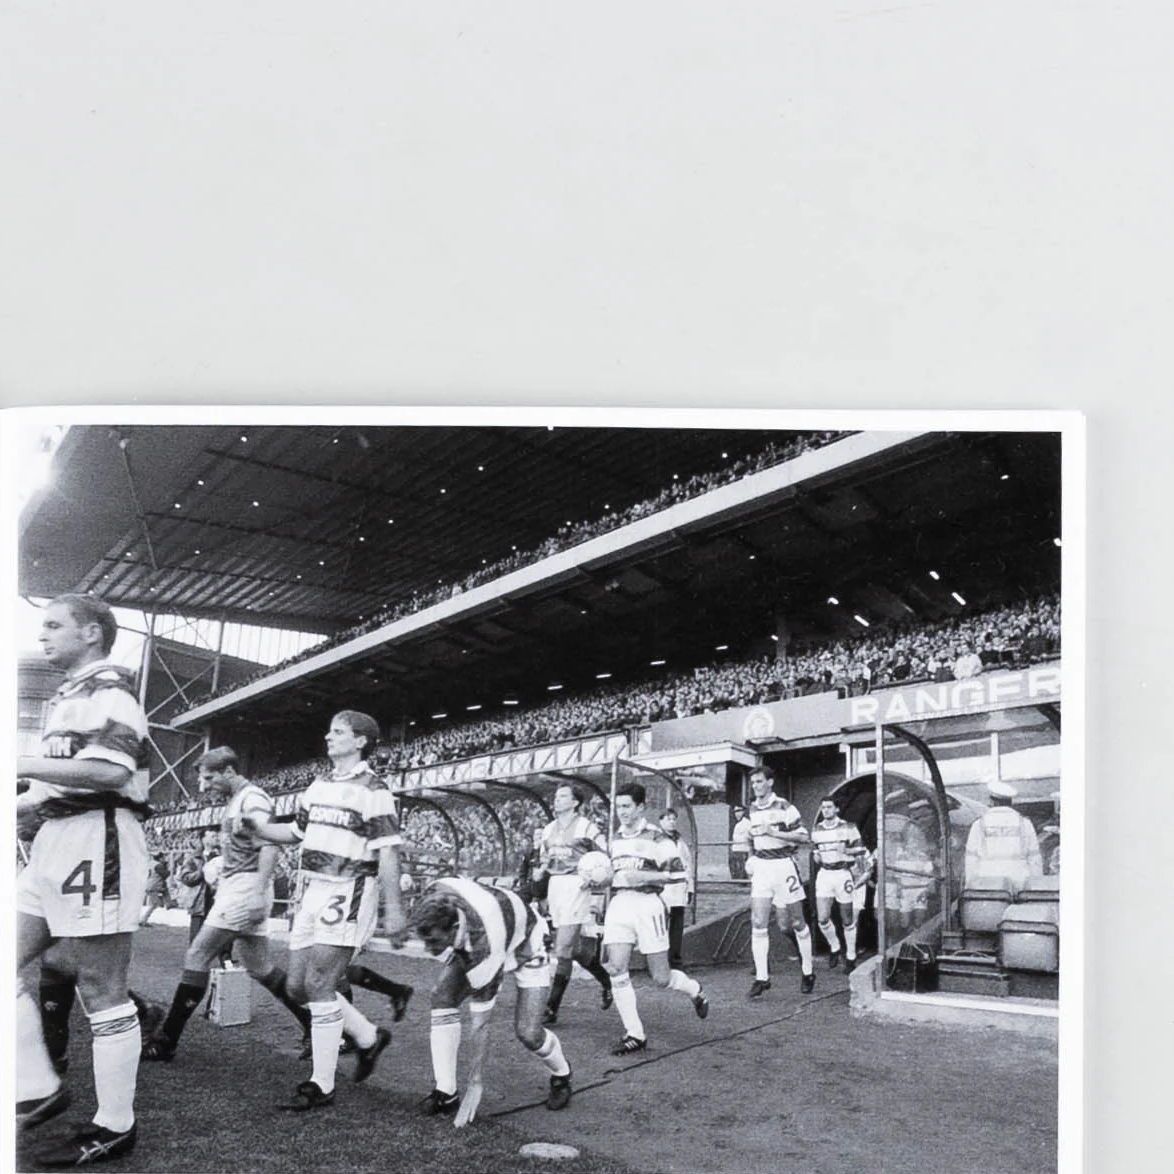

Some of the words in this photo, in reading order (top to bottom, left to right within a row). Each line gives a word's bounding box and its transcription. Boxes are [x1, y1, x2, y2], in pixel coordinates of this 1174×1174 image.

[61, 860, 97, 906] 4
[785, 875, 799, 893] 2
[843, 879, 854, 894] 6
[320, 895, 347, 926] 3
[652, 914, 665, 937] 11
